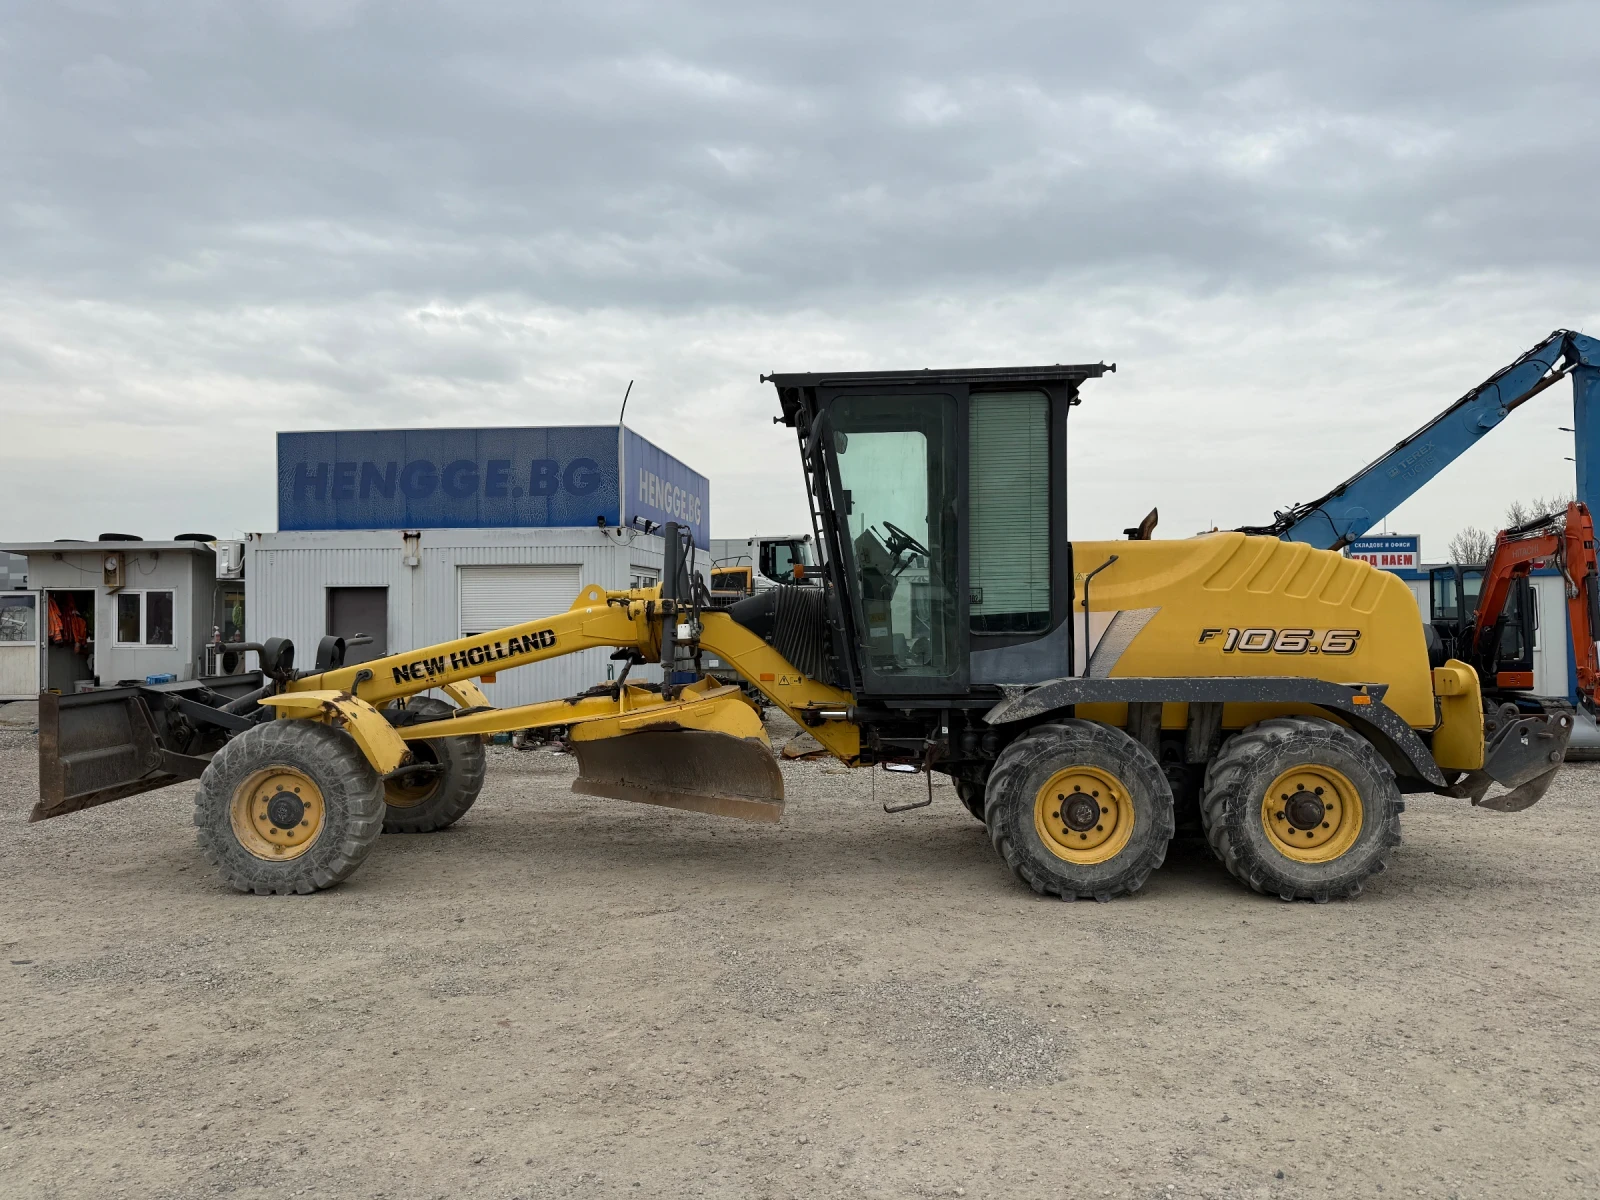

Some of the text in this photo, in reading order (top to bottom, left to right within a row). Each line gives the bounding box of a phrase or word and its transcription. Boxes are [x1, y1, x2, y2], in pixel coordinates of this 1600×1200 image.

[1398, 441, 1436, 468] TEREX
[1402, 456, 1435, 480] FUCHS
[293, 457, 601, 501] HENGGE.BG
[639, 467, 701, 525] HENGGE.BG
[1381, 554, 1413, 566] НАЕМ
[1512, 543, 1539, 558] HITACHI
[392, 629, 557, 685] NEW HOLLAND
